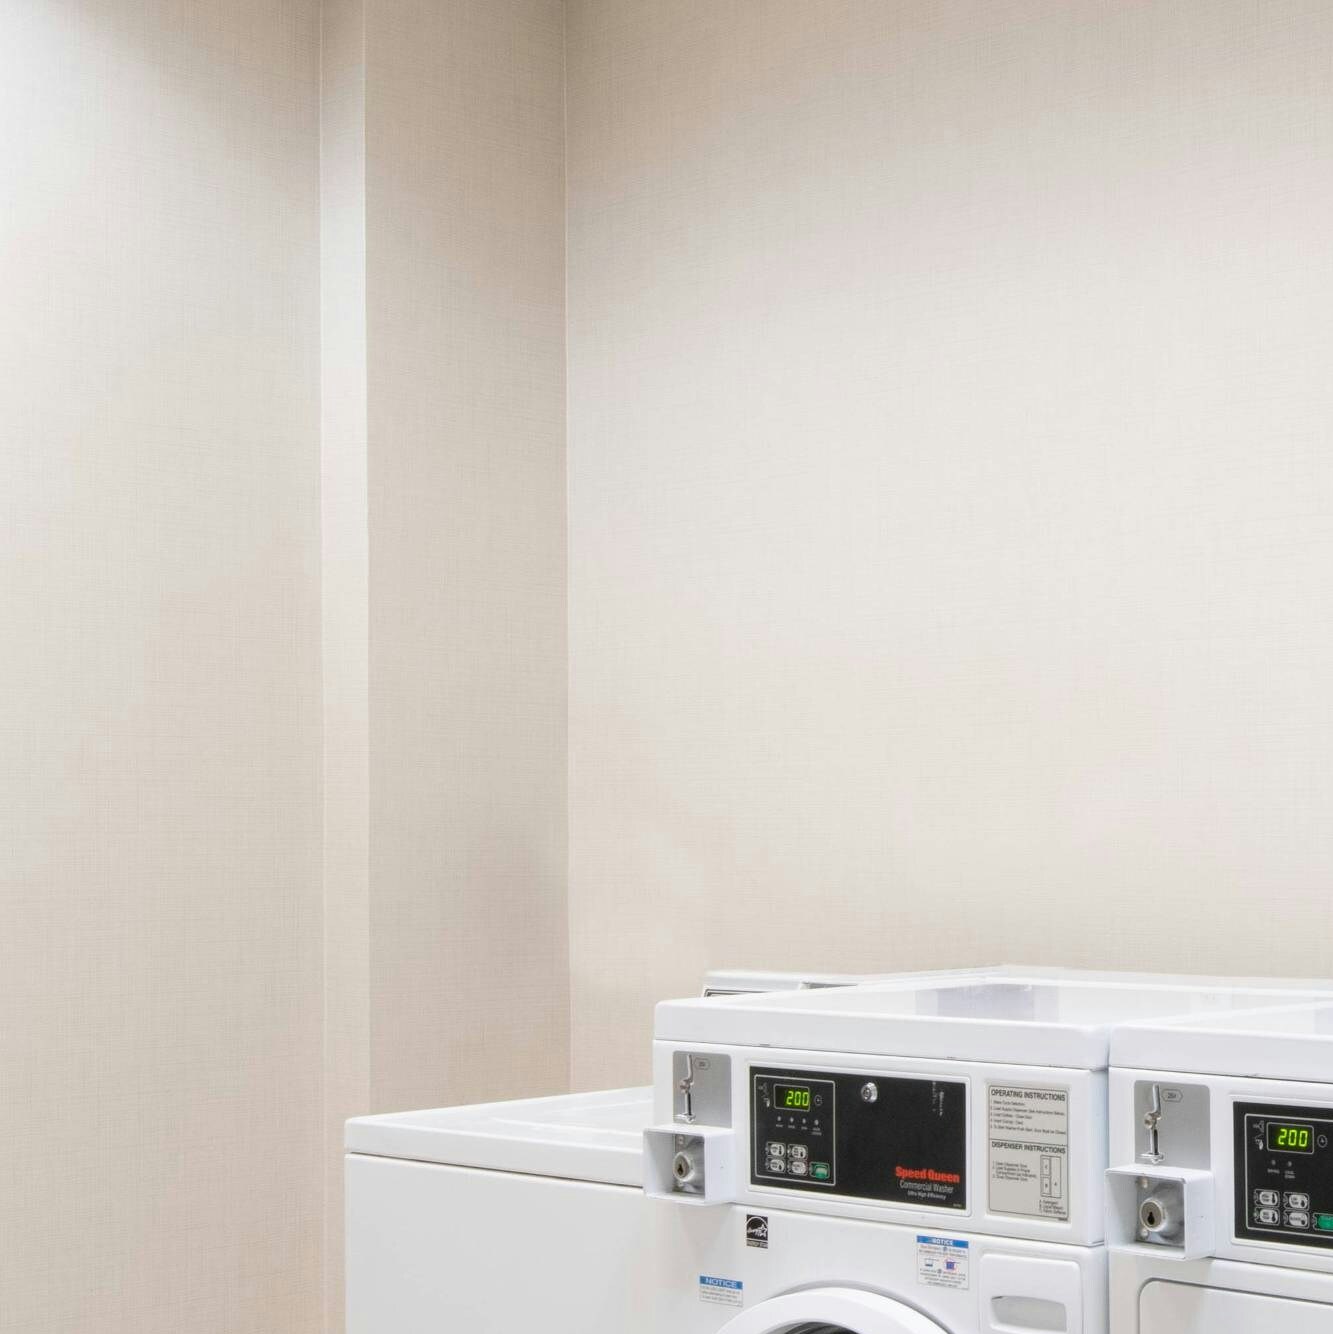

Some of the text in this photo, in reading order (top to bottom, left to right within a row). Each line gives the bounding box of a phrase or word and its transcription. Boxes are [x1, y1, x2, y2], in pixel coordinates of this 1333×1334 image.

[786, 1090, 810, 1106] 200
[991, 1089, 1065, 1101] OPERATING INSTRUCTIONS
[1278, 1129, 1308, 1147] 200
[992, 1142, 1066, 1154] DISPENSER INSTRUCTIONS
[896, 1166, 960, 1183] Speed Queen
[900, 1180, 954, 1193] Commercial Washer
[932, 1238, 953, 1246] NOTICE
[705, 1277, 737, 1288] NOTICE
